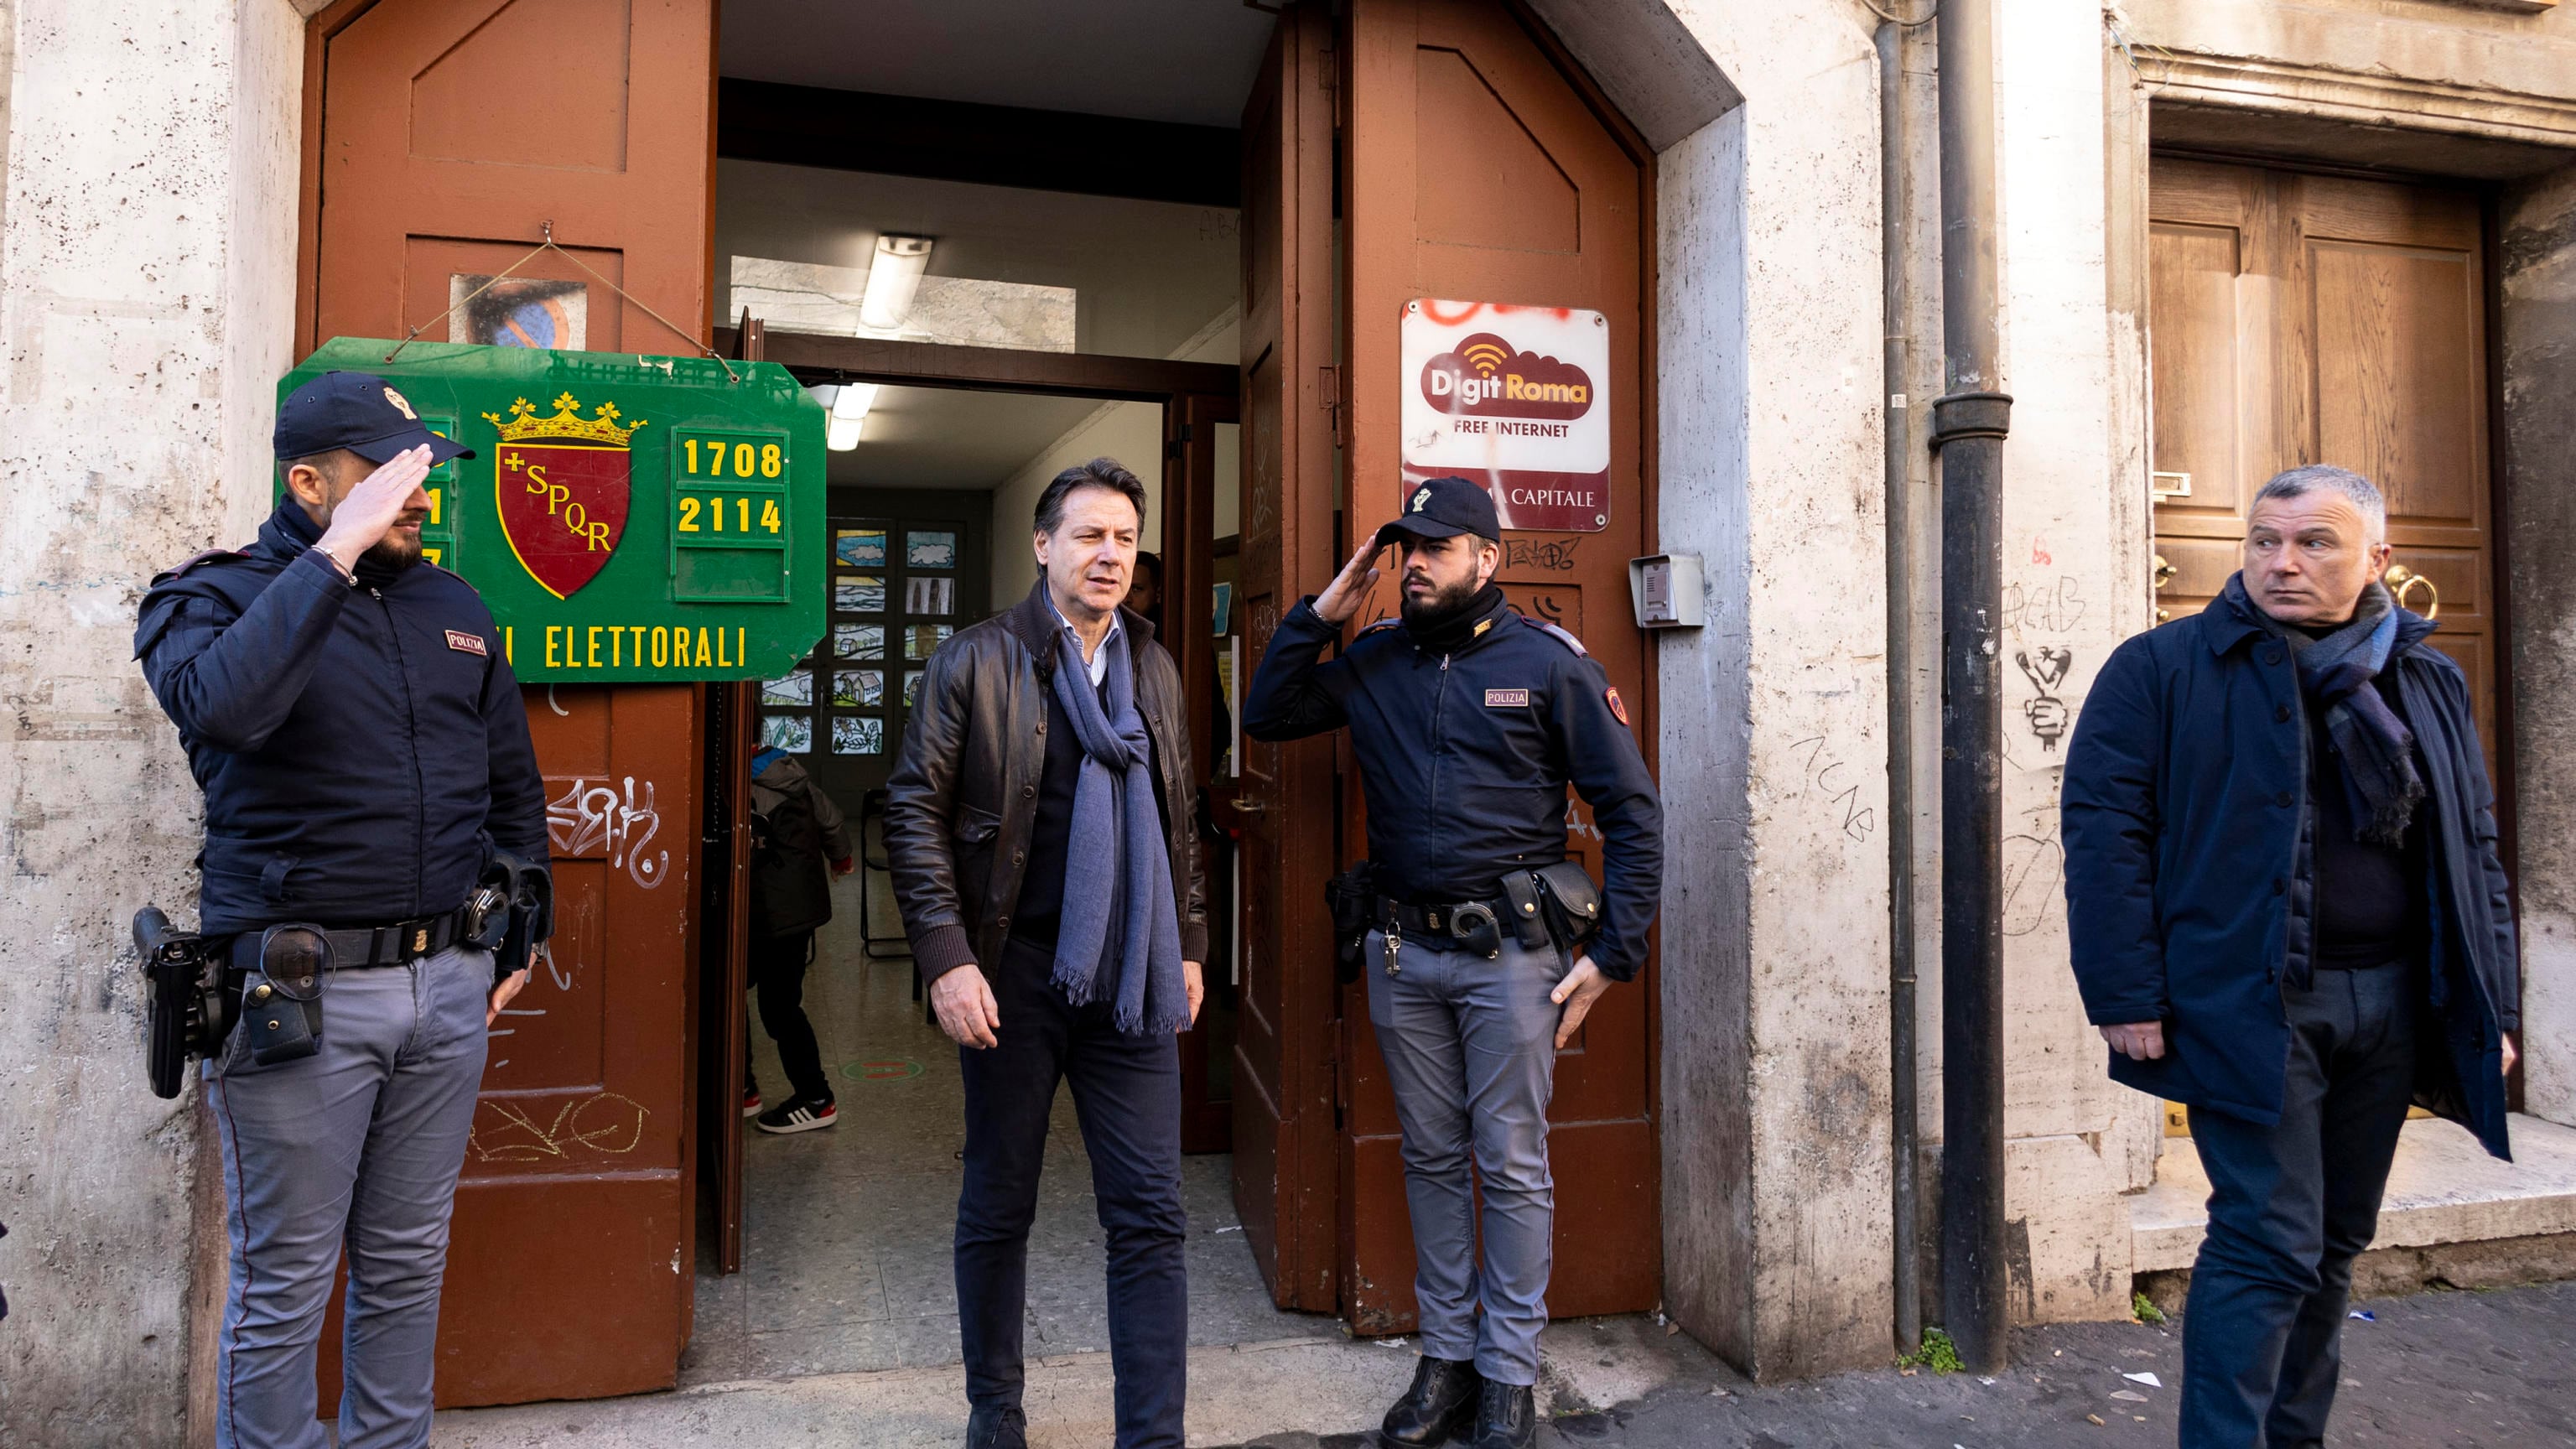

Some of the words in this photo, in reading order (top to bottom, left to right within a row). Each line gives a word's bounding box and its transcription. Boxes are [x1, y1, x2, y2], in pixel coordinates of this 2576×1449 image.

[1454, 419, 1489, 434] FREE
[1495, 421, 1569, 439] INTERNET
[684, 439, 781, 478] 1708
[1511, 488, 1596, 507] CAPITALE
[678, 497, 781, 533] 2114
[449, 634, 485, 652] POLIZIA
[545, 626, 745, 668] ELETTORALI
[1488, 693, 1525, 703] POLIZIA
